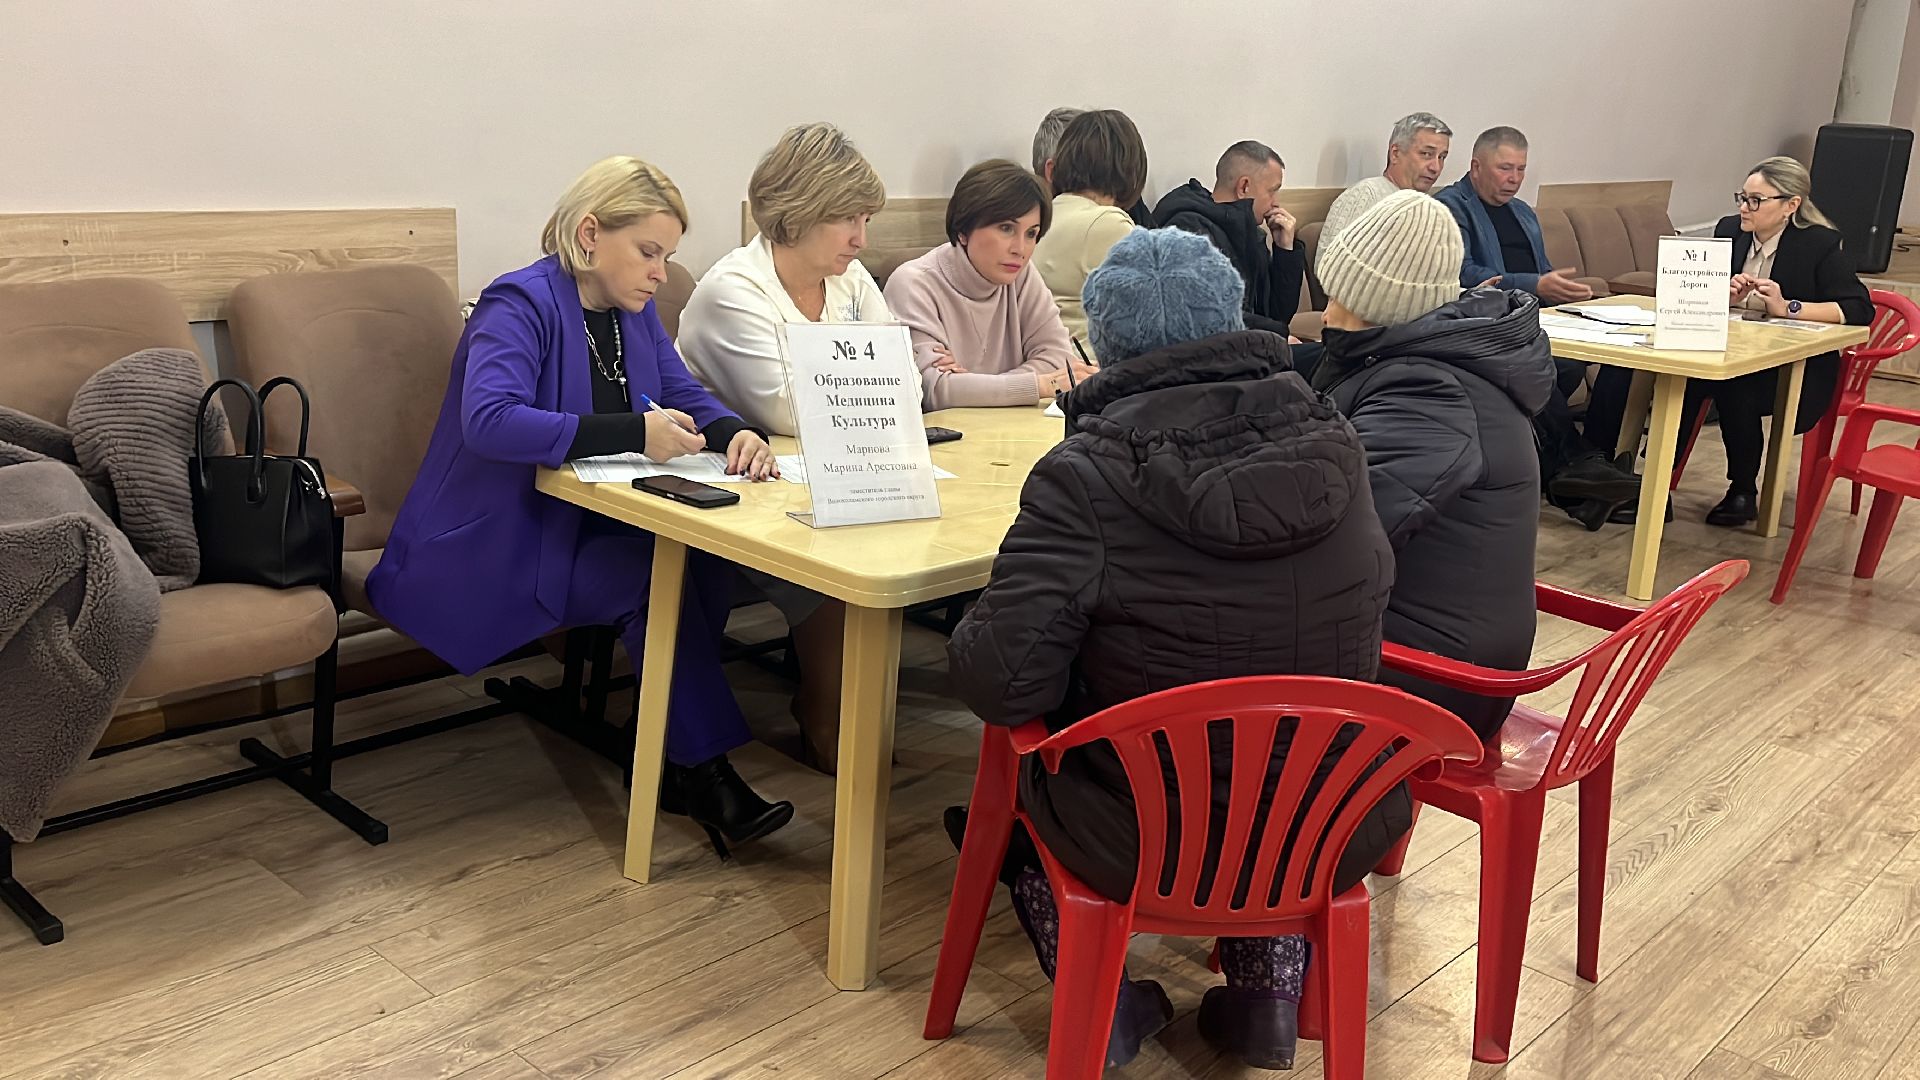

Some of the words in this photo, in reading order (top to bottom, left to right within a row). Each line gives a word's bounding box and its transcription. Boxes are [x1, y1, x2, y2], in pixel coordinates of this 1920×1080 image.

[1683, 249, 1697, 261] №
[1662, 267, 1728, 278] Благоустройство
[1680, 280, 1708, 290] Дороги
[832, 340, 857, 360] №
[863, 340, 875, 360] 4
[814, 373, 901, 389] Образование
[826, 394, 895, 408] Медицина
[831, 415, 896, 430] Культура
[823, 462, 863, 476] Марина
[866, 461, 917, 475] Арестовна
